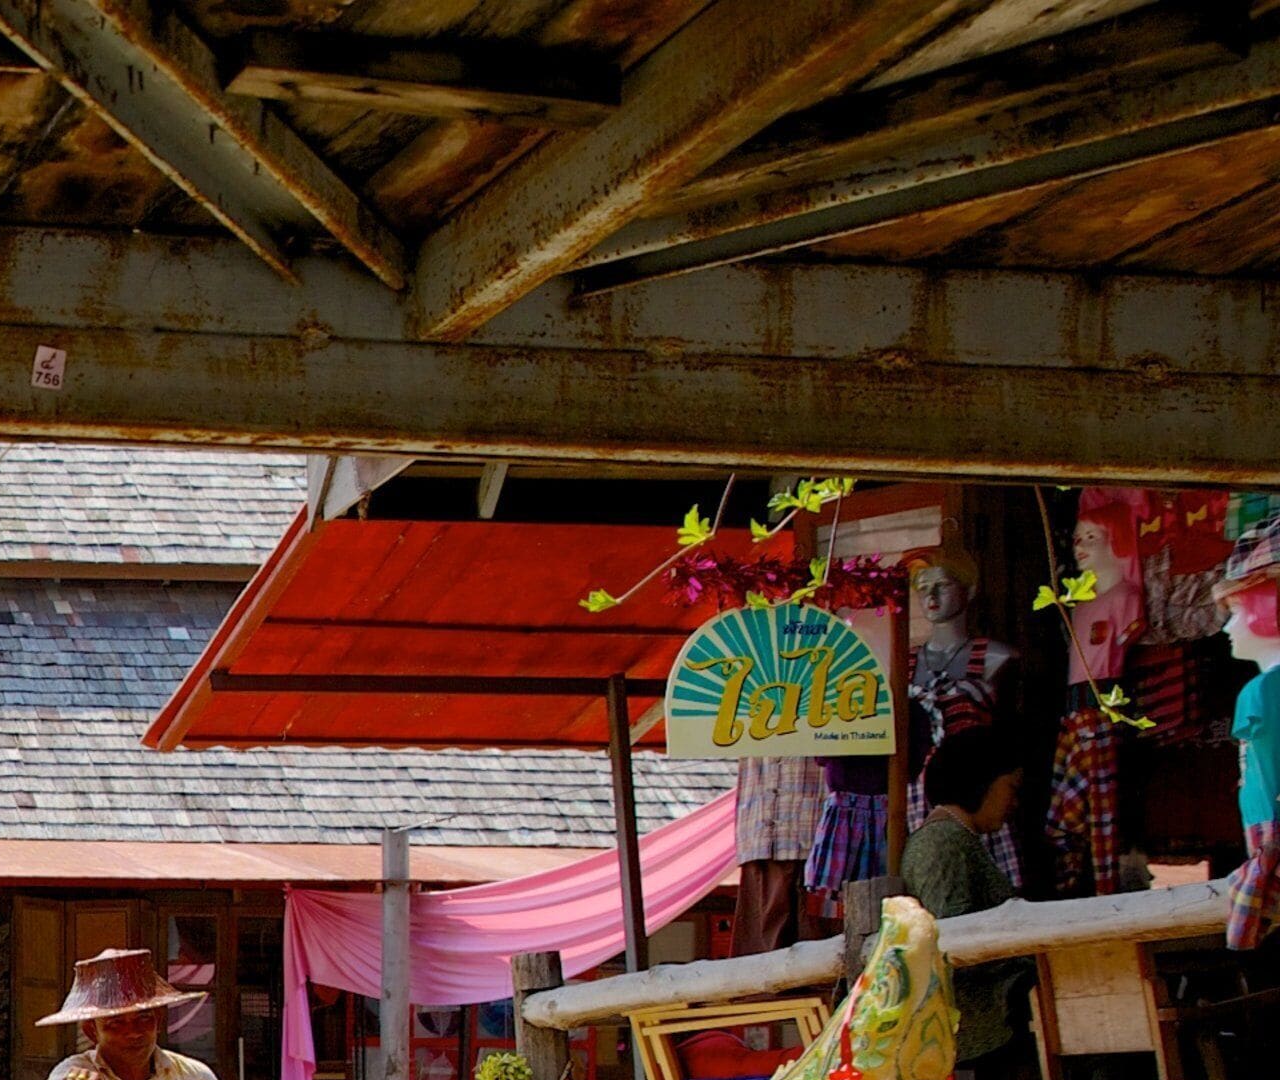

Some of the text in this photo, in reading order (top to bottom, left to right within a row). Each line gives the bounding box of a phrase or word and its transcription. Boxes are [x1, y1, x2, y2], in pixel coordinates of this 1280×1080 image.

[35, 371, 60, 386] 756
[685, 646, 879, 746] ไฉไล
[814, 732, 839, 740] Made
[841, 732, 849, 740] in
